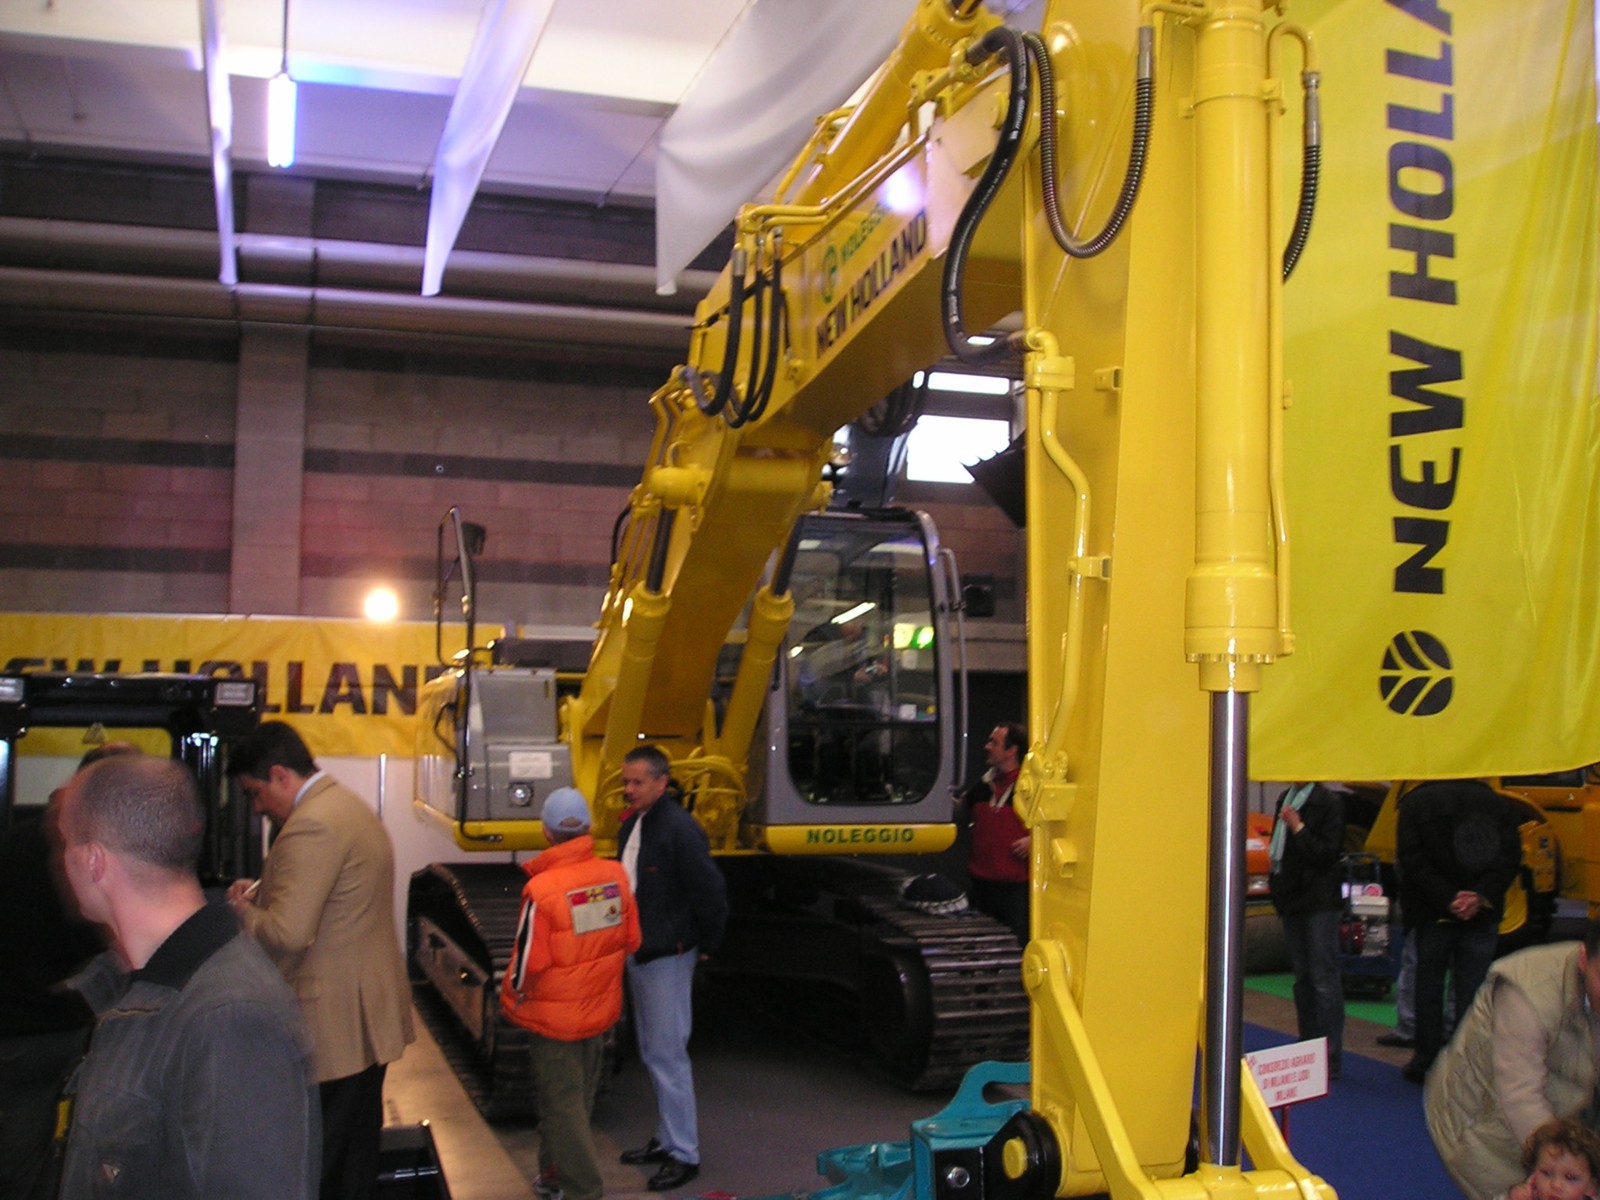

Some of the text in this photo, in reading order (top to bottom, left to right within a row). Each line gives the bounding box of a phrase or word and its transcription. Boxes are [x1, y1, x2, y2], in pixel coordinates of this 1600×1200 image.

[817, 208, 927, 359] NEW HOLLAND
[1387, 330, 1466, 595] NEW
[807, 828, 915, 844] NOLEGGIO
